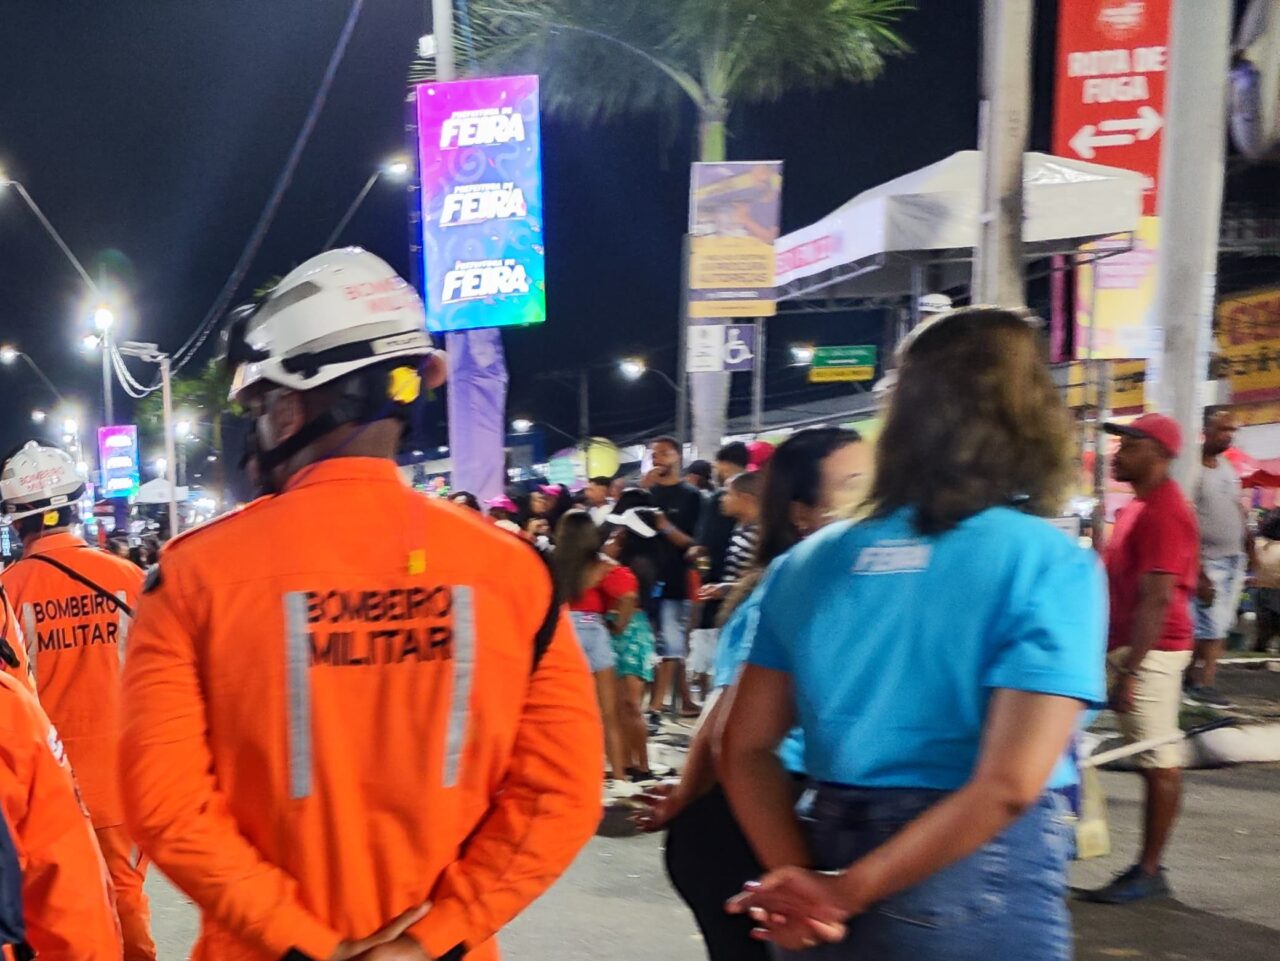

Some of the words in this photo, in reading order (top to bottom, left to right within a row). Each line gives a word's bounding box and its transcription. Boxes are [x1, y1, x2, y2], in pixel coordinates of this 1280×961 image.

[440, 113, 526, 148] FEIRA
[439, 188, 527, 223] FEIRA
[441, 265, 530, 301] FEIRA
[33, 592, 119, 624] BOMBEIRO
[304, 585, 453, 623] BOMBEIRO
[37, 623, 119, 652] MILITAR
[306, 626, 453, 667] MILITAR
